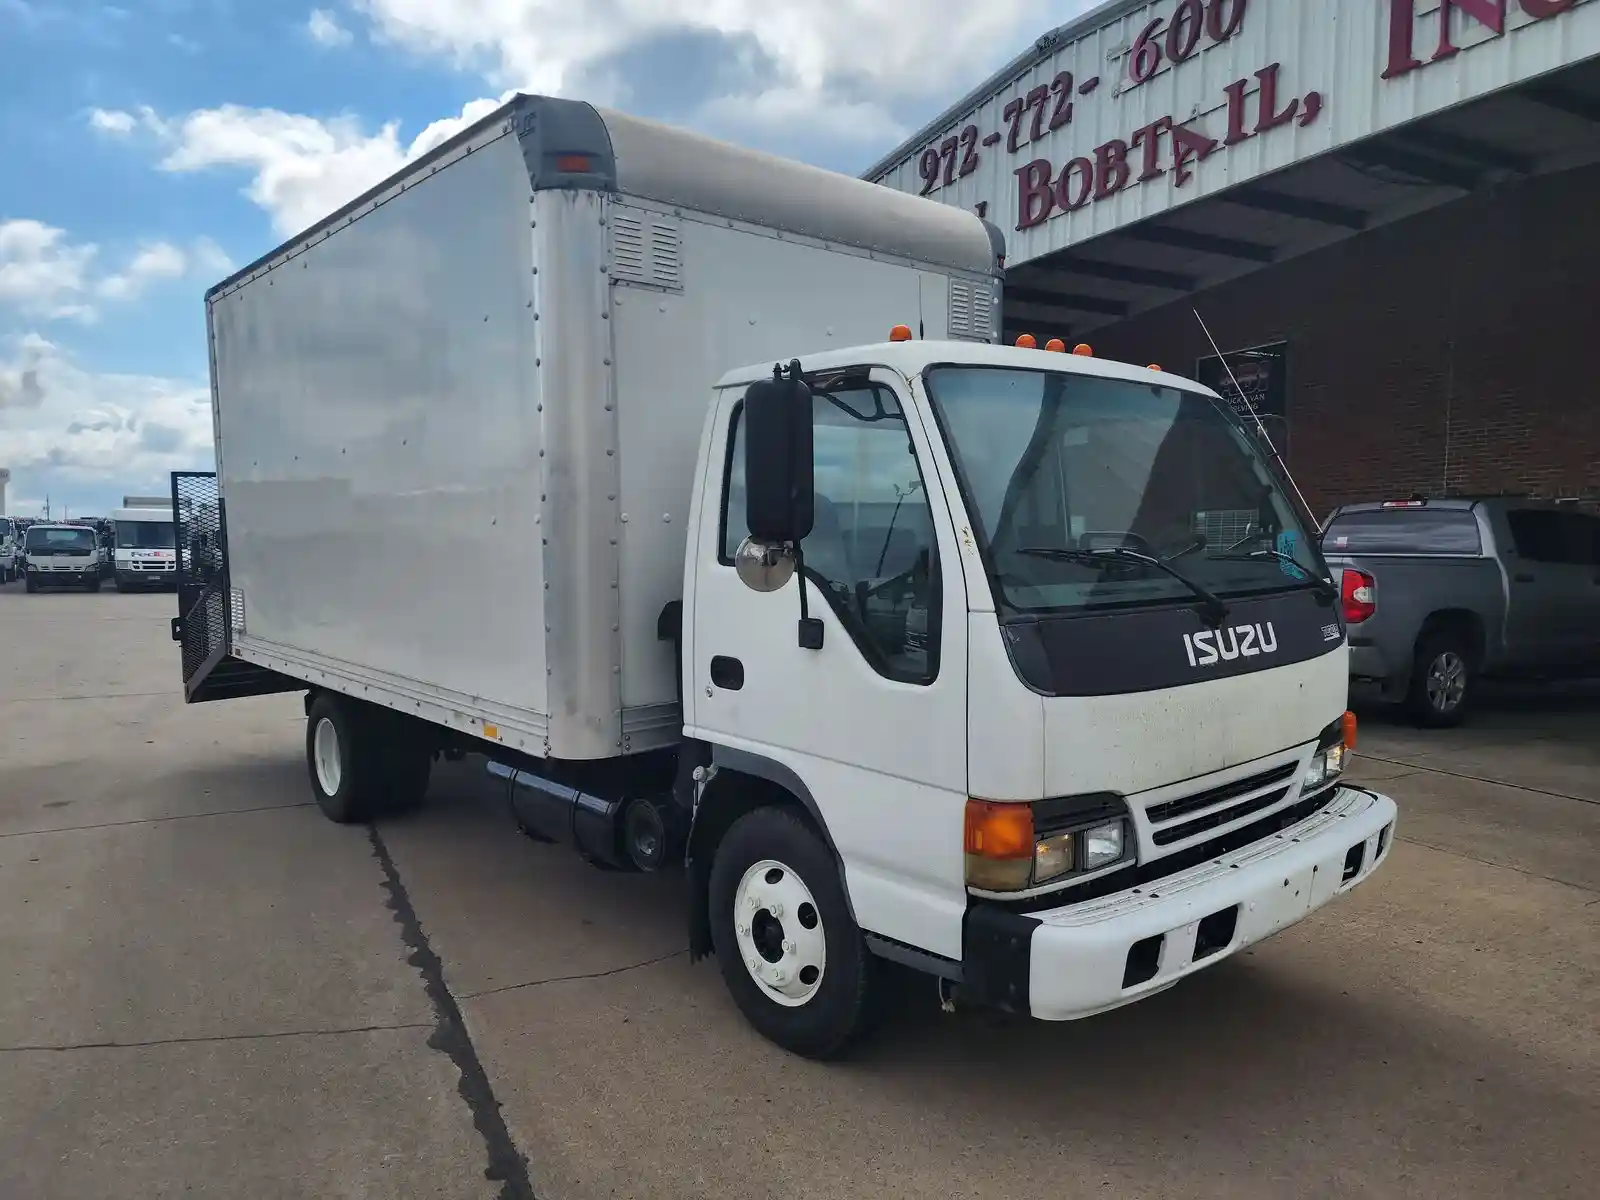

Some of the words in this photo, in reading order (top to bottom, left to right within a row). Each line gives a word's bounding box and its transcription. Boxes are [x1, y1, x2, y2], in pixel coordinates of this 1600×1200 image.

[1380, 0, 1576, 80] IN
[1249, 393, 1265, 402] VAN
[1183, 621, 1277, 667] ISUZU
